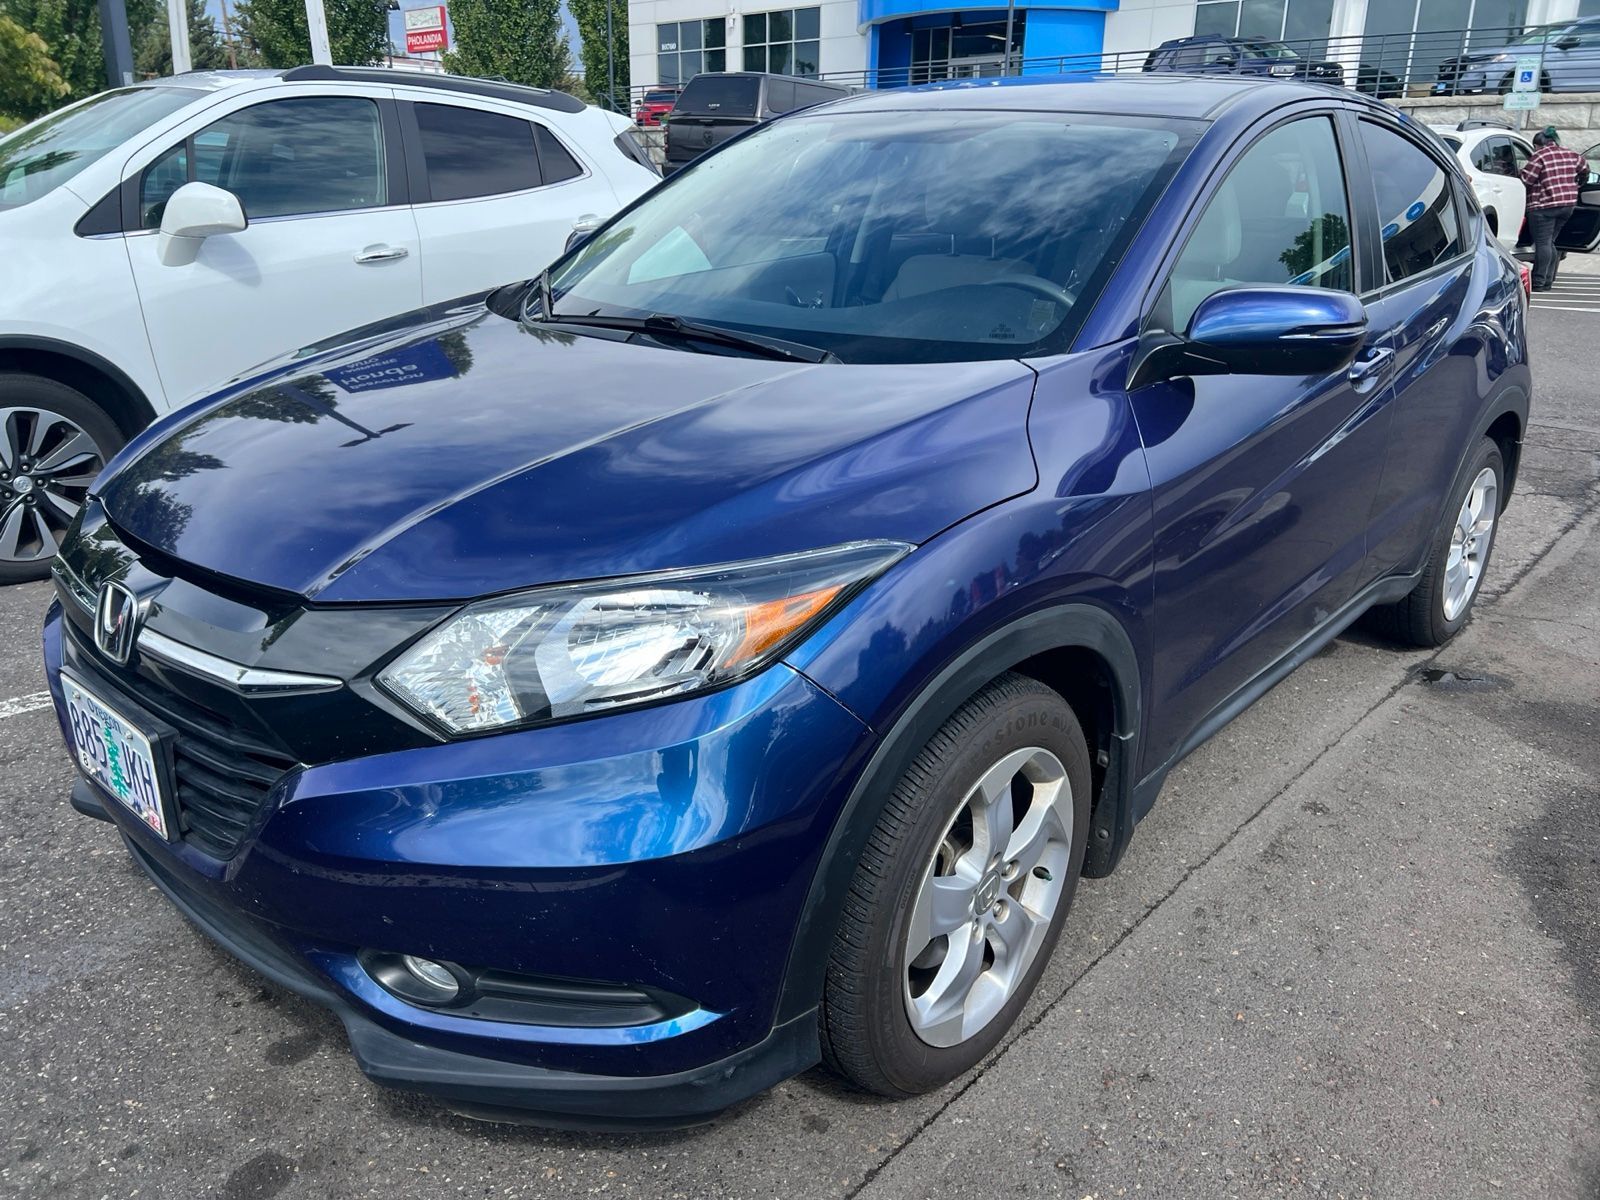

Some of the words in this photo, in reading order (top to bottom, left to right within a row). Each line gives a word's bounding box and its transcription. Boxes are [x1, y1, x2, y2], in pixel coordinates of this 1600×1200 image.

[407, 33, 442, 46] PHOLANDIA
[87, 697, 122, 735] Oregon
[69, 701, 107, 767] 885
[121, 741, 158, 811] JKH
